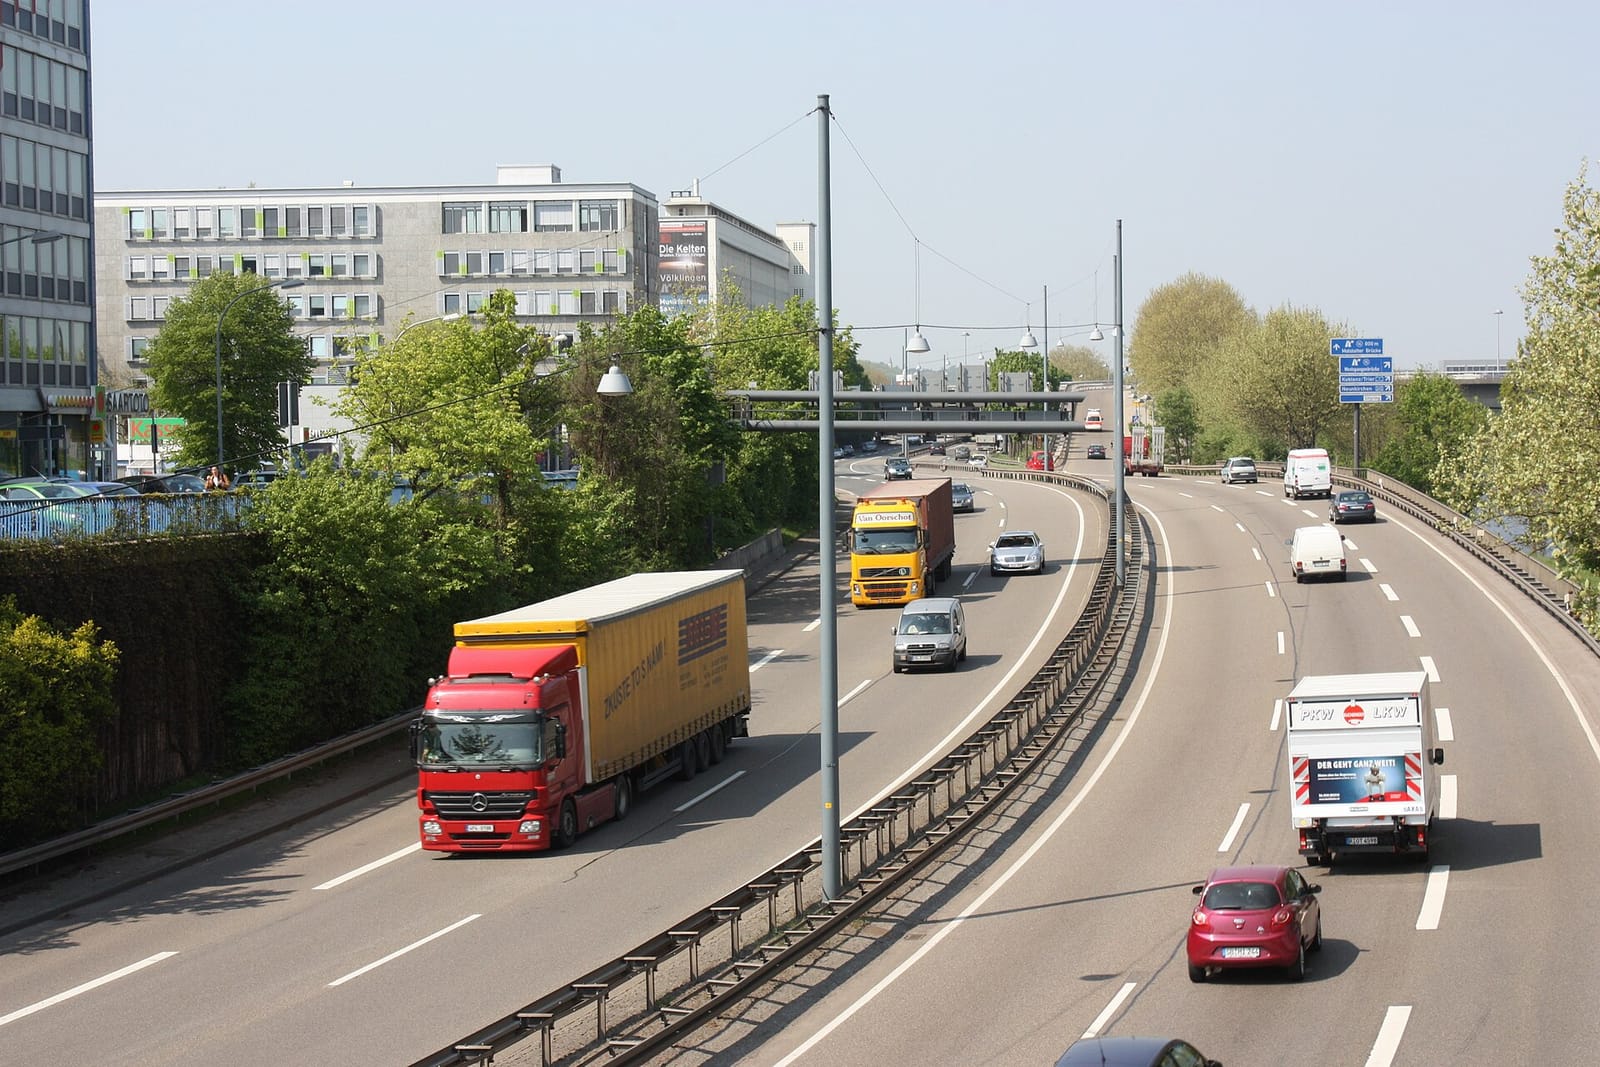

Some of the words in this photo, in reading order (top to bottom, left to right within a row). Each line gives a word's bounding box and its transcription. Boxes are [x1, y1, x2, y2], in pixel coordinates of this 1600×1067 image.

[659, 244, 674, 254] Die
[676, 243, 706, 253] Kelten
[660, 274, 706, 283] Völklingen
[106, 392, 149, 413] SAARTOTO
[874, 513, 912, 521] Oorschot
[631, 666, 640, 689] TO
[641, 660, 646, 679] S
[1301, 709, 1335, 721] PKW
[1373, 705, 1408, 719] LKW
[1317, 761, 1332, 770] DER
[1333, 760, 1352, 769] GEHT
[1353, 759, 1374, 769] GANZ
